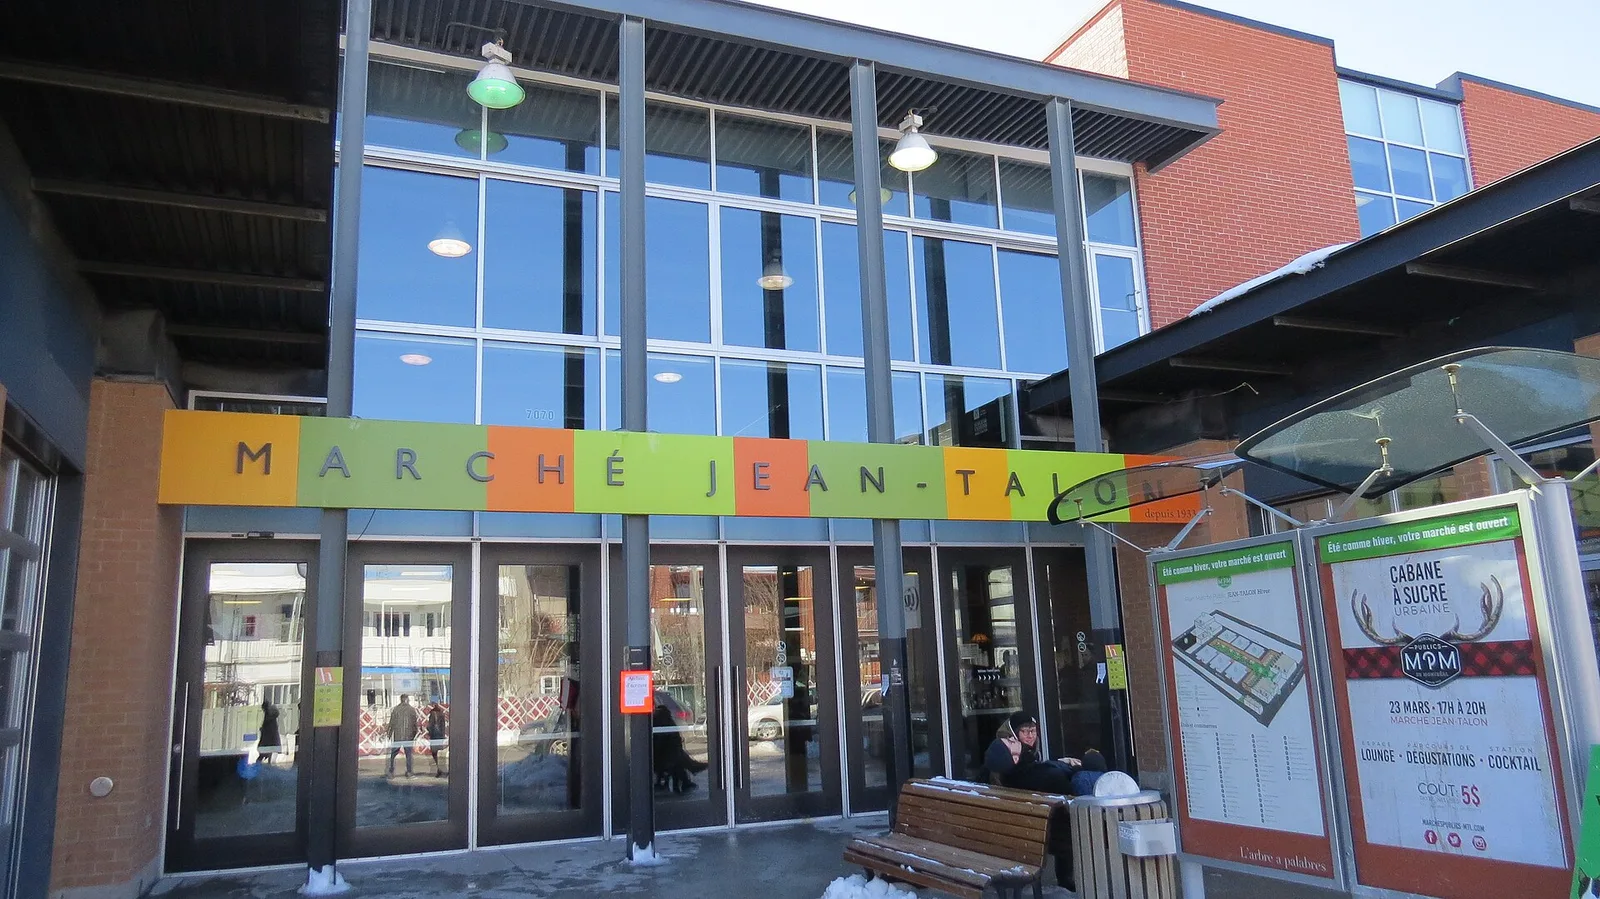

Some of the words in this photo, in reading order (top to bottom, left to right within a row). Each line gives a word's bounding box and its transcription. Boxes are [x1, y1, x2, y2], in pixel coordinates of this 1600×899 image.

[526, 408, 555, 420] 7070
[235, 441, 625, 487] MARCHÉ
[1144, 508, 1174, 521] depuis
[1327, 541, 1341, 553] Été
[1342, 539, 1371, 551] comme
[1372, 535, 1397, 547] hiver,
[1397, 530, 1421, 543] votre
[1422, 523, 1456, 539] marché
[1458, 521, 1475, 533] est
[1476, 516, 1509, 531] ouvert
[1162, 565, 1173, 577] Été
[1173, 565, 1194, 575] comme
[1194, 562, 1211, 573] hiver,
[1211, 560, 1228, 569] votre
[1228, 554, 1252, 567] marché
[1252, 553, 1264, 563] est
[1265, 550, 1287, 561] ouvert
[1390, 560, 1443, 583] CABANE
[1392, 584, 1402, 606] À
[1403, 583, 1448, 605] SUCRE
[1394, 602, 1450, 617] URBAINE
[1389, 700, 1401, 714] 23
[1403, 700, 1430, 714] MARS
[1436, 701, 1454, 715] 17H
[1457, 698, 1464, 715] À
[1465, 701, 1487, 715] 20H
[1361, 748, 1395, 763] LOUNGE
[1487, 754, 1541, 771] COCKTAIL
[1461, 784, 1481, 807] 5$
[1240, 846, 1273, 862] L'arbre
[1284, 855, 1327, 872] palabres
